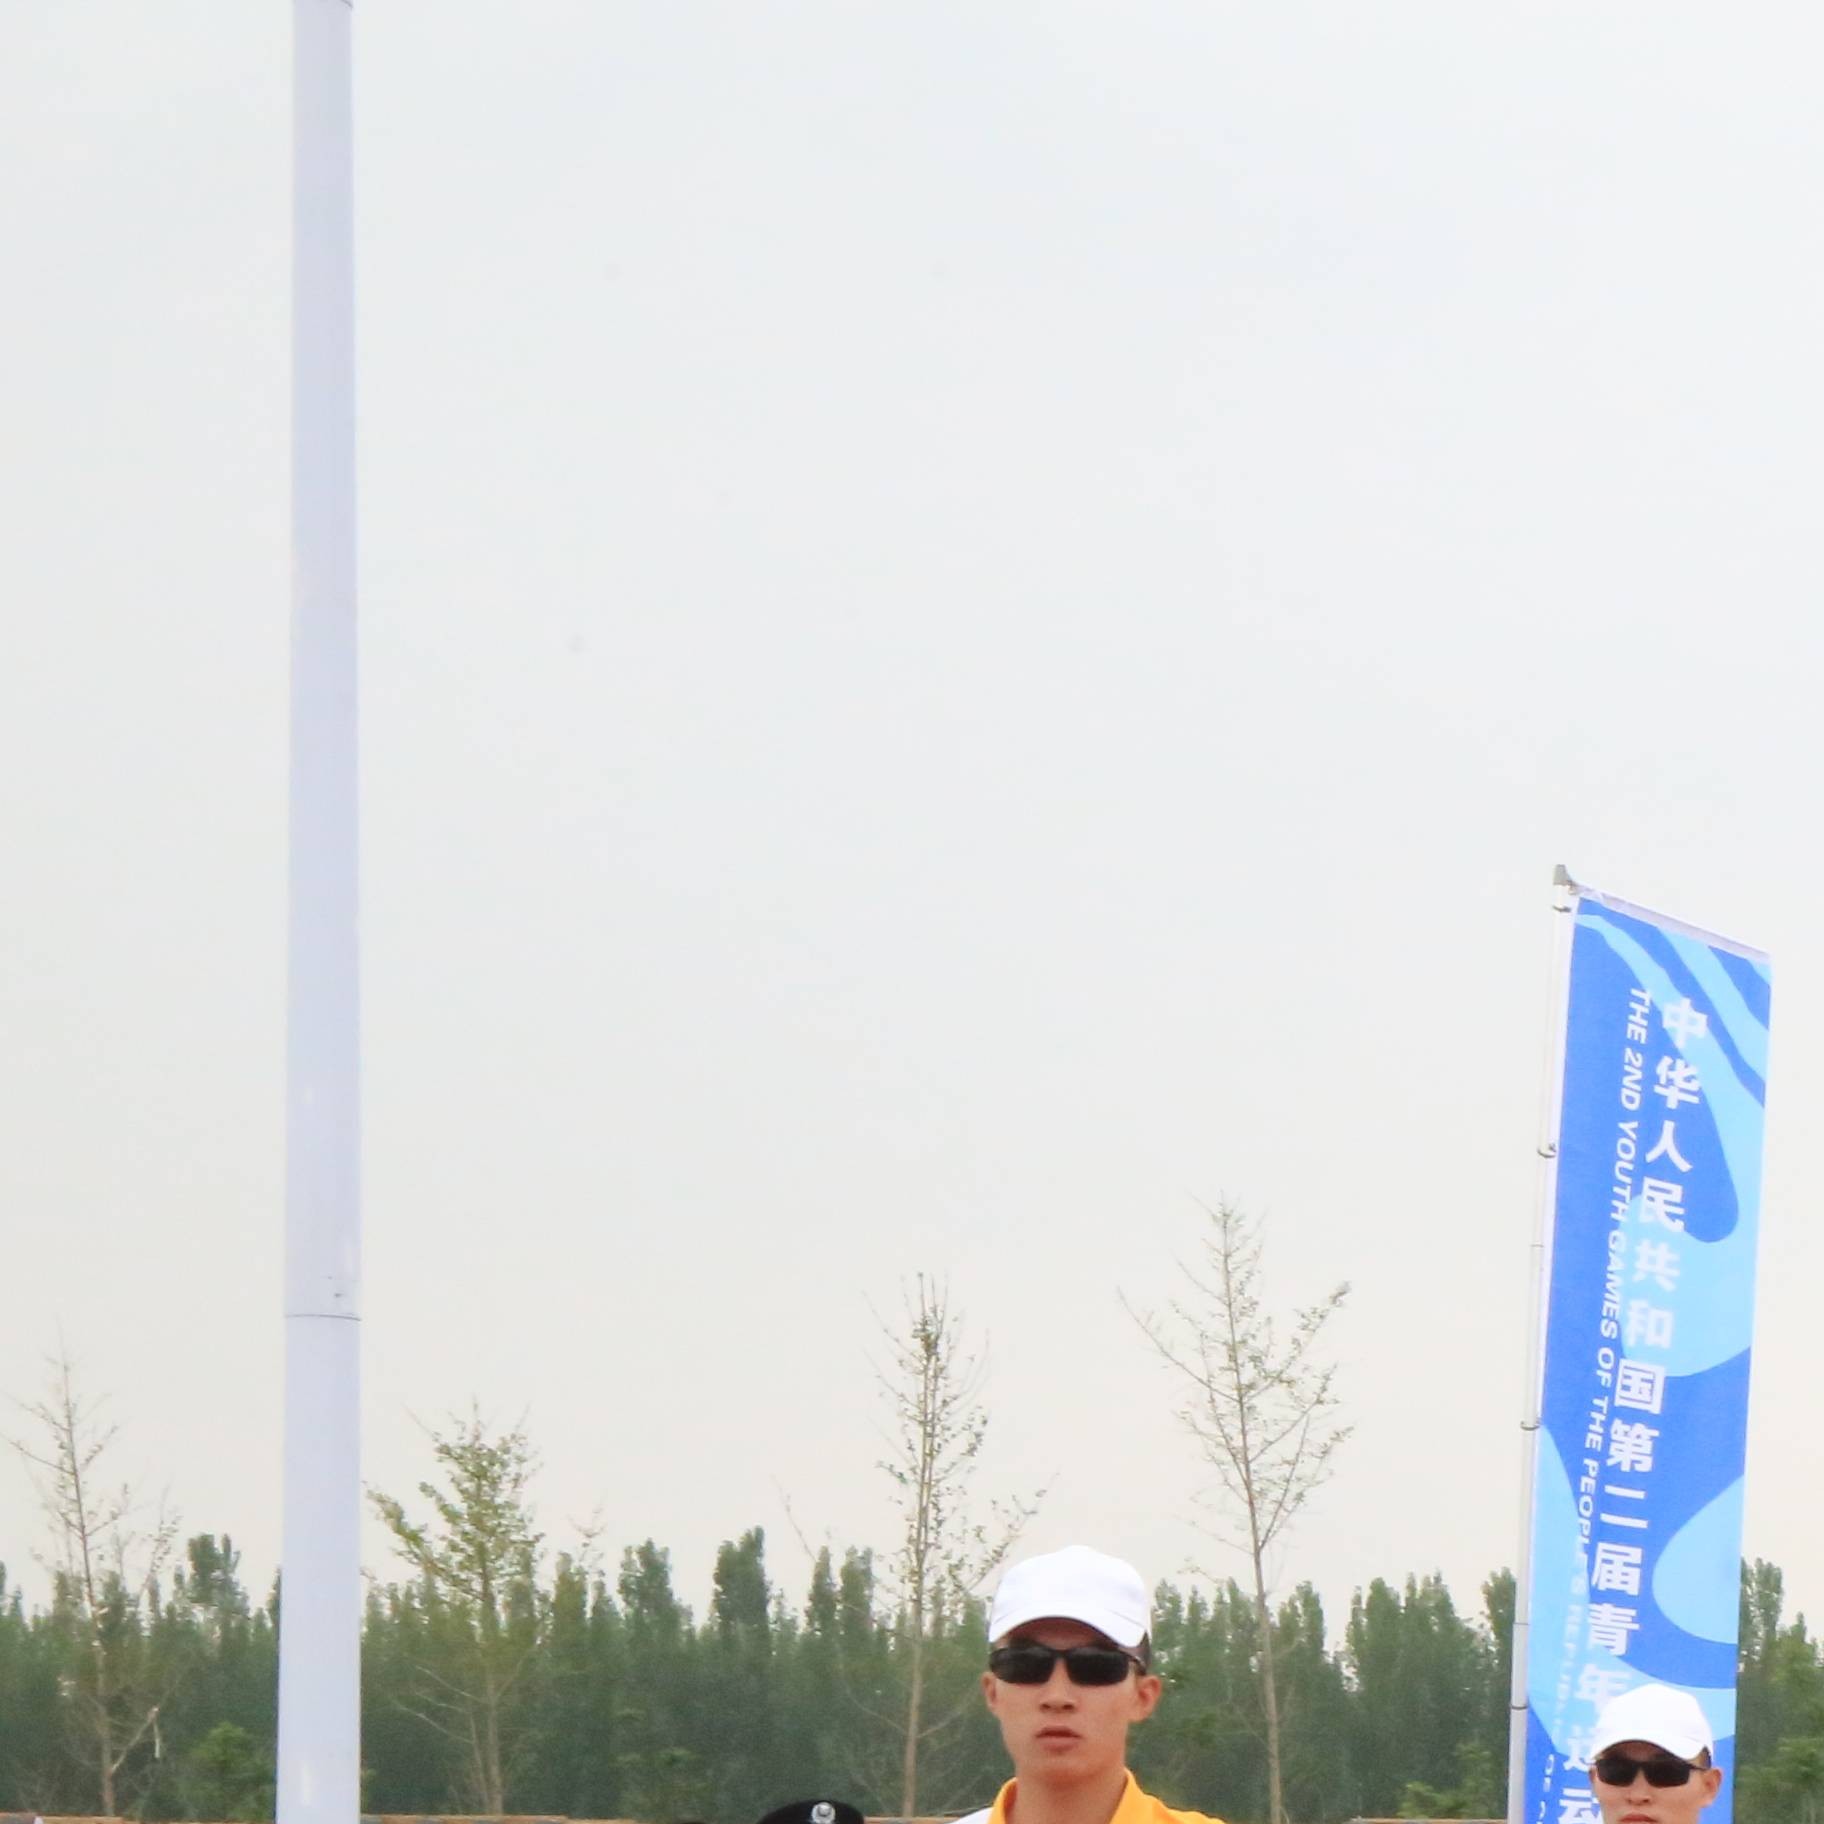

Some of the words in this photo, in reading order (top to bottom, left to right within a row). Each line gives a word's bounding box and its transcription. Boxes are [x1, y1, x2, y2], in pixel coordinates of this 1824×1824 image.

[1626, 986, 1650, 1045] THE
[1621, 1048, 1643, 1112] 2ND
[1610, 1120, 1639, 1223] YOUTH
[1601, 1230, 1627, 1340] GAMES
[1595, 1346, 1615, 1388] OF
[1584, 1394, 1609, 1452] THE
